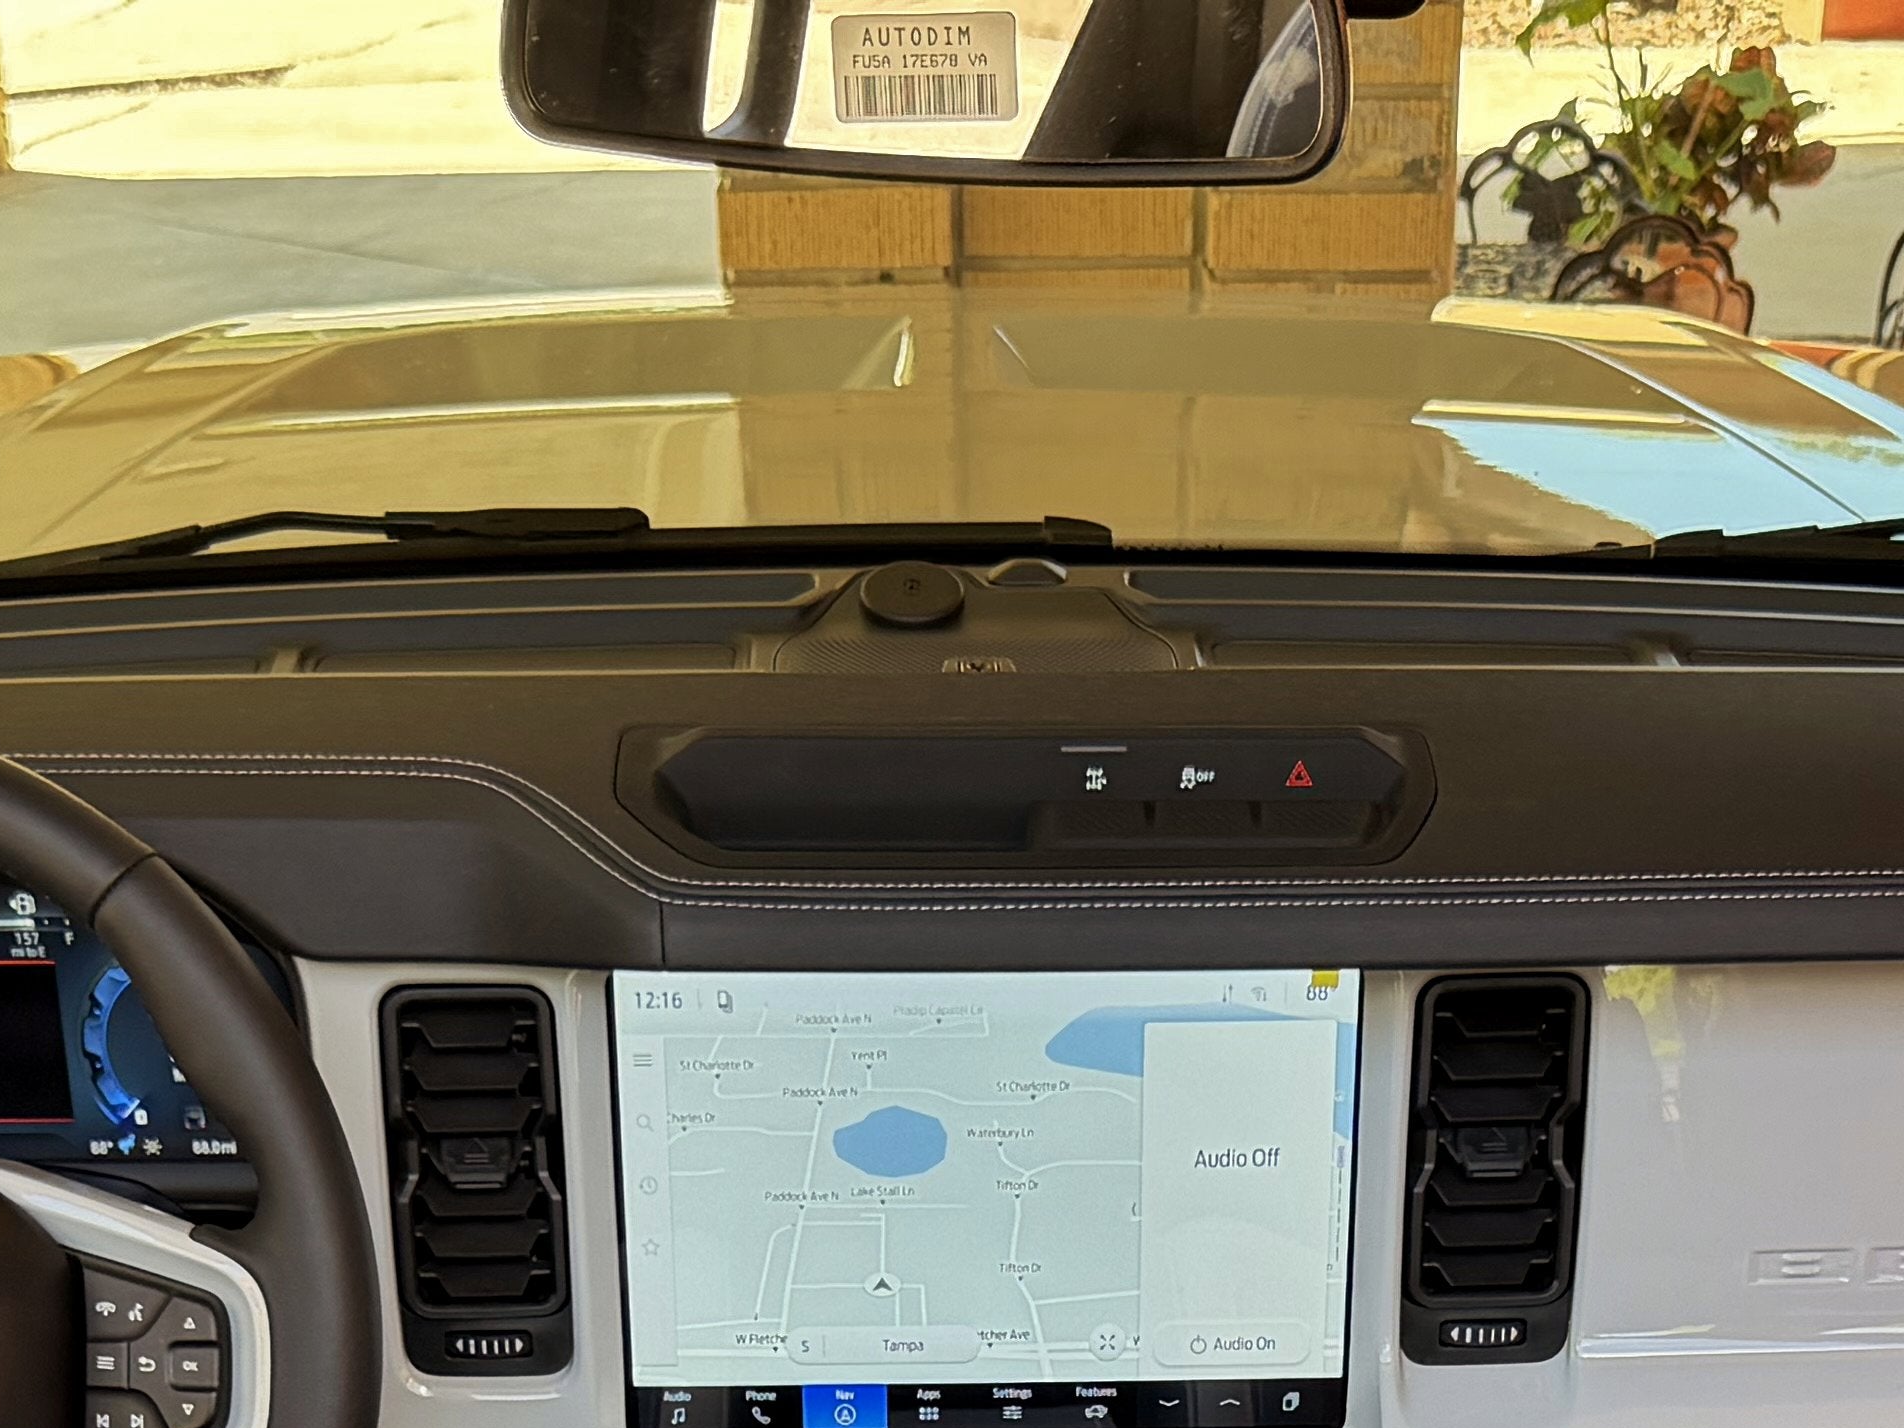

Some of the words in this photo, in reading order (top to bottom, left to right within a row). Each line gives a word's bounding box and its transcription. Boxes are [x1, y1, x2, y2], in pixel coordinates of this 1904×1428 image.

[862, 26, 971, 46] AUTODIM
[853, 54, 891, 69] FU5A
[902, 54, 958, 68] 17E678
[968, 53, 988, 66] VA
[14, 932, 39, 946] 157
[635, 991, 683, 1010] 12:16
[783, 1087, 826, 1098] Paddock
[828, 1087, 848, 1098] Ave
[850, 1087, 858, 1097] N
[1008, 1081, 1057, 1092] Charlotte
[1059, 1081, 1071, 1092] Dr
[1022, 1128, 1034, 1138] Ln
[1194, 1149, 1248, 1169] Audio
[1252, 1148, 1280, 1168] Off
[996, 1180, 1026, 1191] Tifton
[1028, 1180, 1039, 1191] Dr
[764, 1191, 807, 1202] Paddock
[809, 1191, 829, 1201] Ave
[999, 1262, 1030, 1273] Tifton
[1032, 1262, 1042, 1272] Dr
[736, 1335, 747, 1344] W
[1010, 1329, 1031, 1340] Ave
[801, 1340, 810, 1352] S
[882, 1339, 925, 1353] Tampa
[1213, 1336, 1253, 1352] Audio
[1256, 1336, 1277, 1351] On
[663, 1391, 692, 1402] Audio
[745, 1390, 777, 1402] Phone
[835, 1389, 855, 1401] Nav
[916, 1389, 941, 1402] Apps
[992, 1387, 1033, 1400] Settings
[1075, 1385, 1118, 1398] Features
